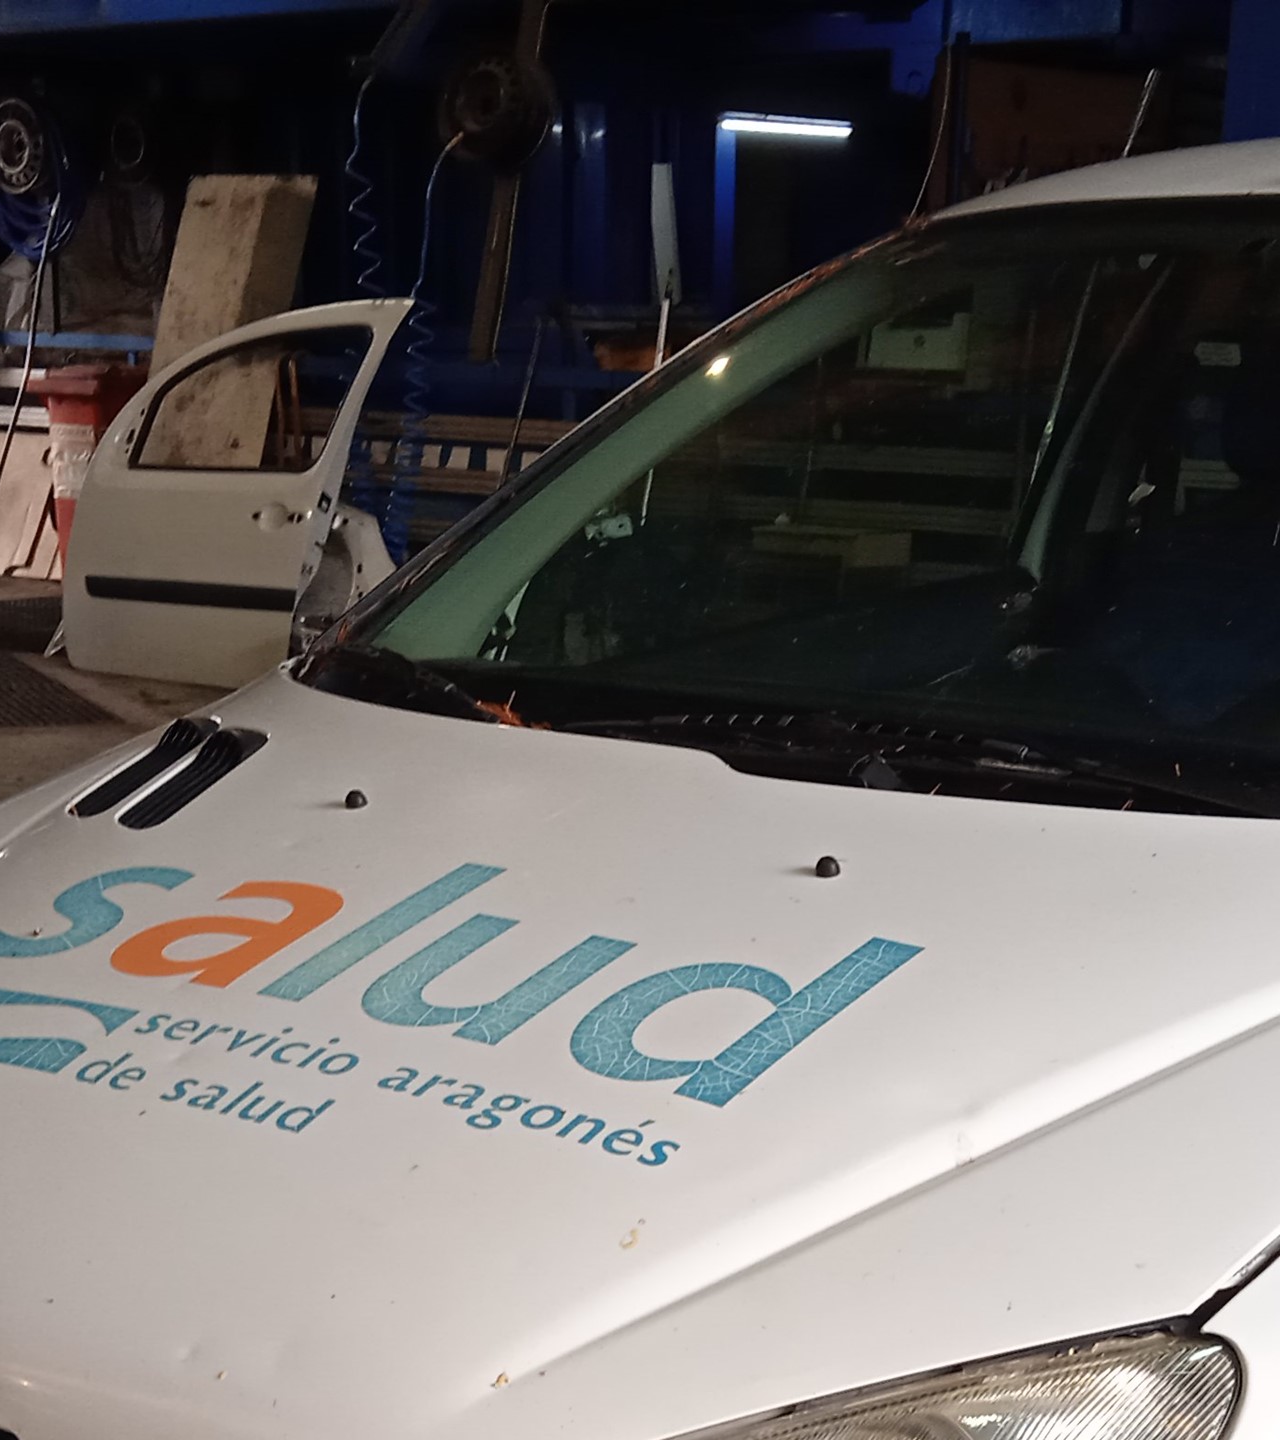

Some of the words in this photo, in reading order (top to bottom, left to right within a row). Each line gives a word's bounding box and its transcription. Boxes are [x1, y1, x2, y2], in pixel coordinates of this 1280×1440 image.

[75, 1051, 147, 1091] de
[159, 1078, 337, 1134] salud
[133, 1013, 360, 1076] servicio
[376, 1066, 682, 1167] aragonés
